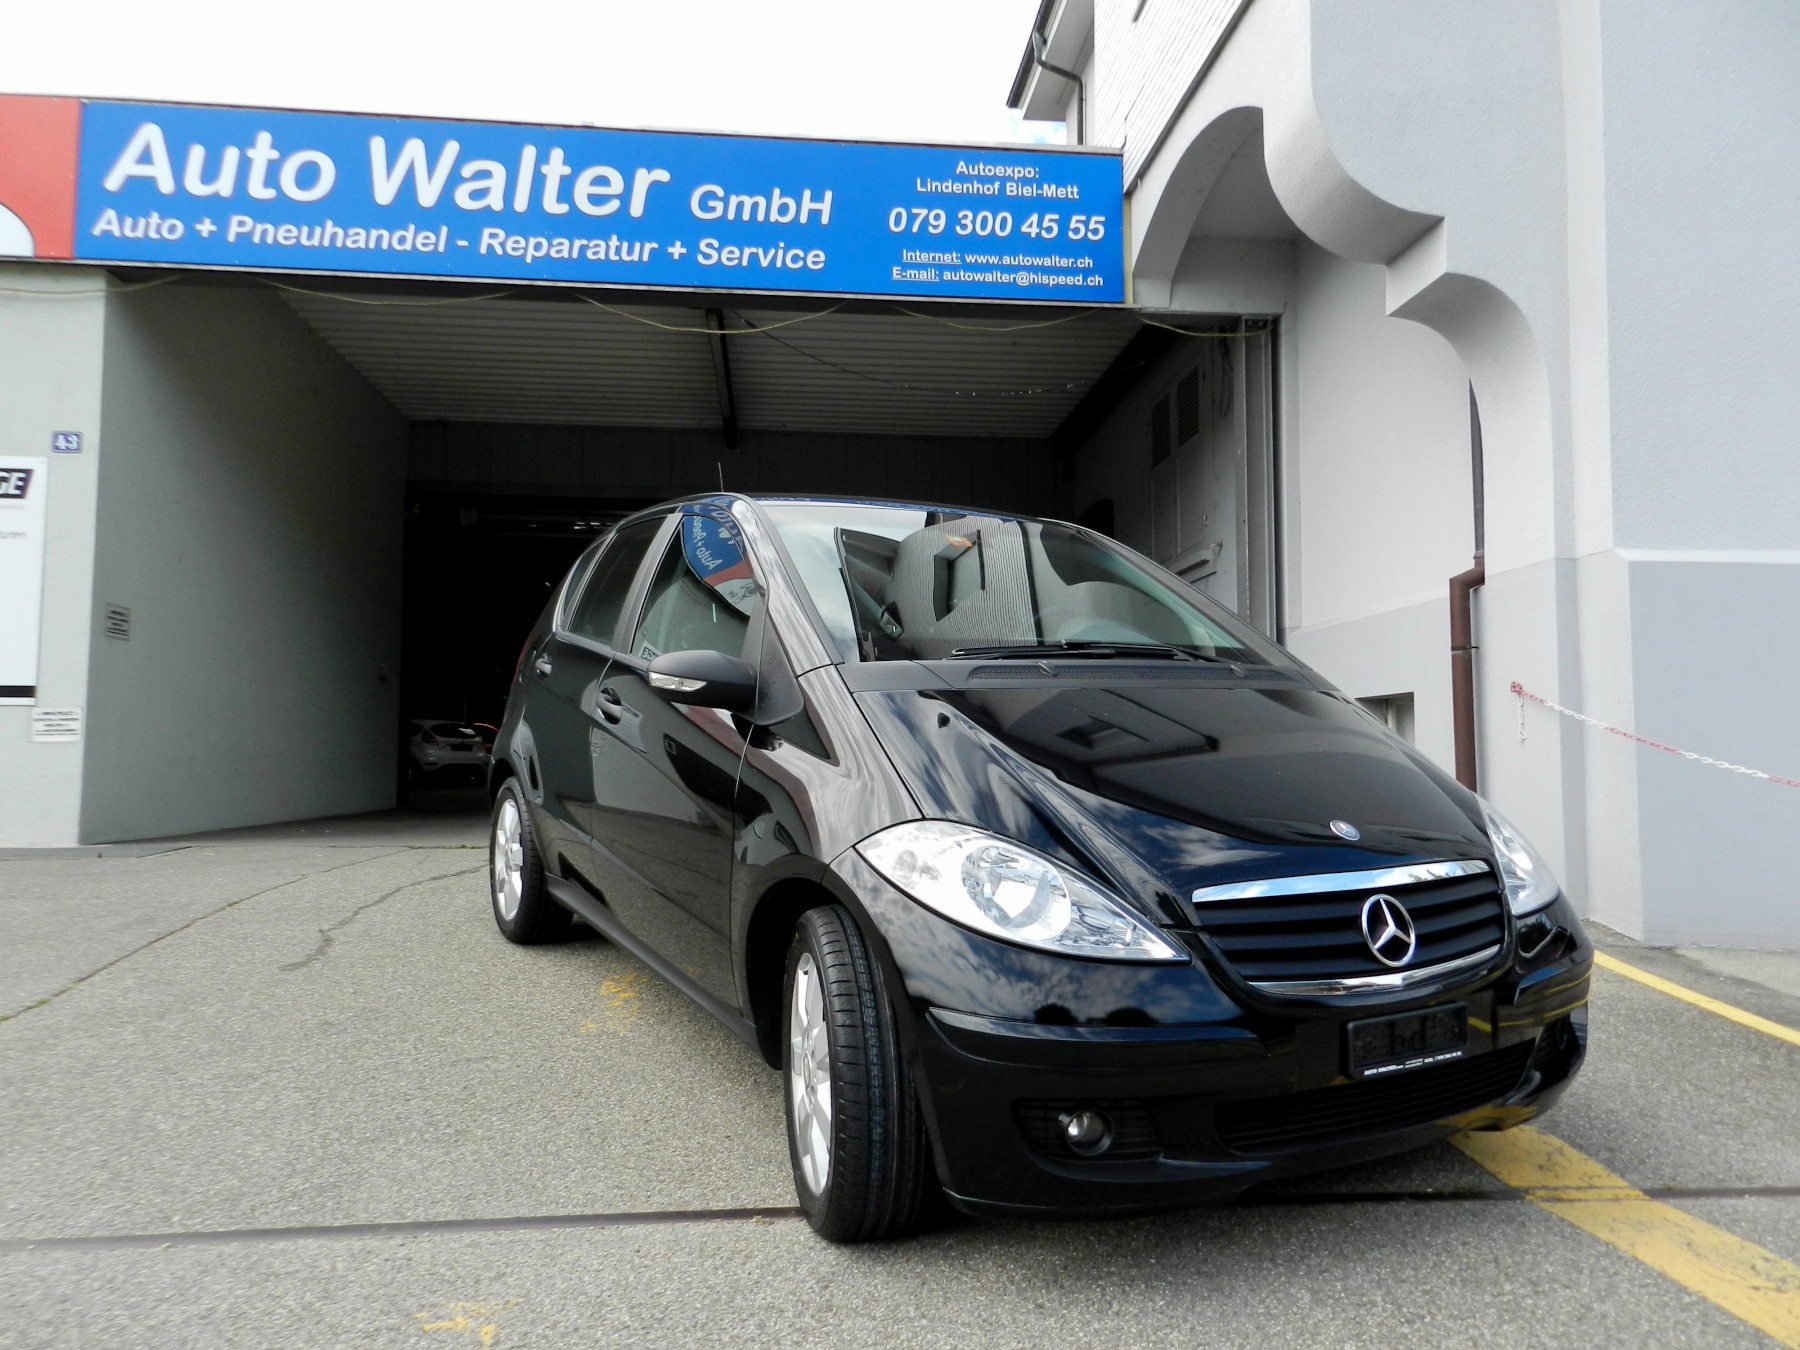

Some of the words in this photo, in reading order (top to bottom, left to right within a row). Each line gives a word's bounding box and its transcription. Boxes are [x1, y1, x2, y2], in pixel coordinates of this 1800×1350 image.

[102, 121, 337, 203] Auto
[368, 134, 671, 220] Walter
[690, 183, 834, 226] GmbH
[955, 160, 1041, 181] Autoexpo:
[916, 177, 1001, 195] Lindenhof
[1005, 181, 1080, 199] Biel-Mett
[888, 207, 947, 235] 079
[955, 210, 1013, 237] 300
[1020, 212, 1060, 239] 45
[1067, 214, 1106, 241] 55
[91, 207, 184, 241] Auto
[193, 217, 217, 238] +
[226, 214, 449, 253] Pneuhandel
[478, 227, 660, 264] Reparatur
[667, 240, 687, 260] +
[696, 237, 827, 270] Service
[901, 249, 962, 265] Internet:
[964, 253, 1093, 268] www.autowalter.ch
[892, 266, 940, 281] E-mail:
[942, 270, 1105, 287] autowalter@hispeed.ch
[56, 433, 78, 451] 43
